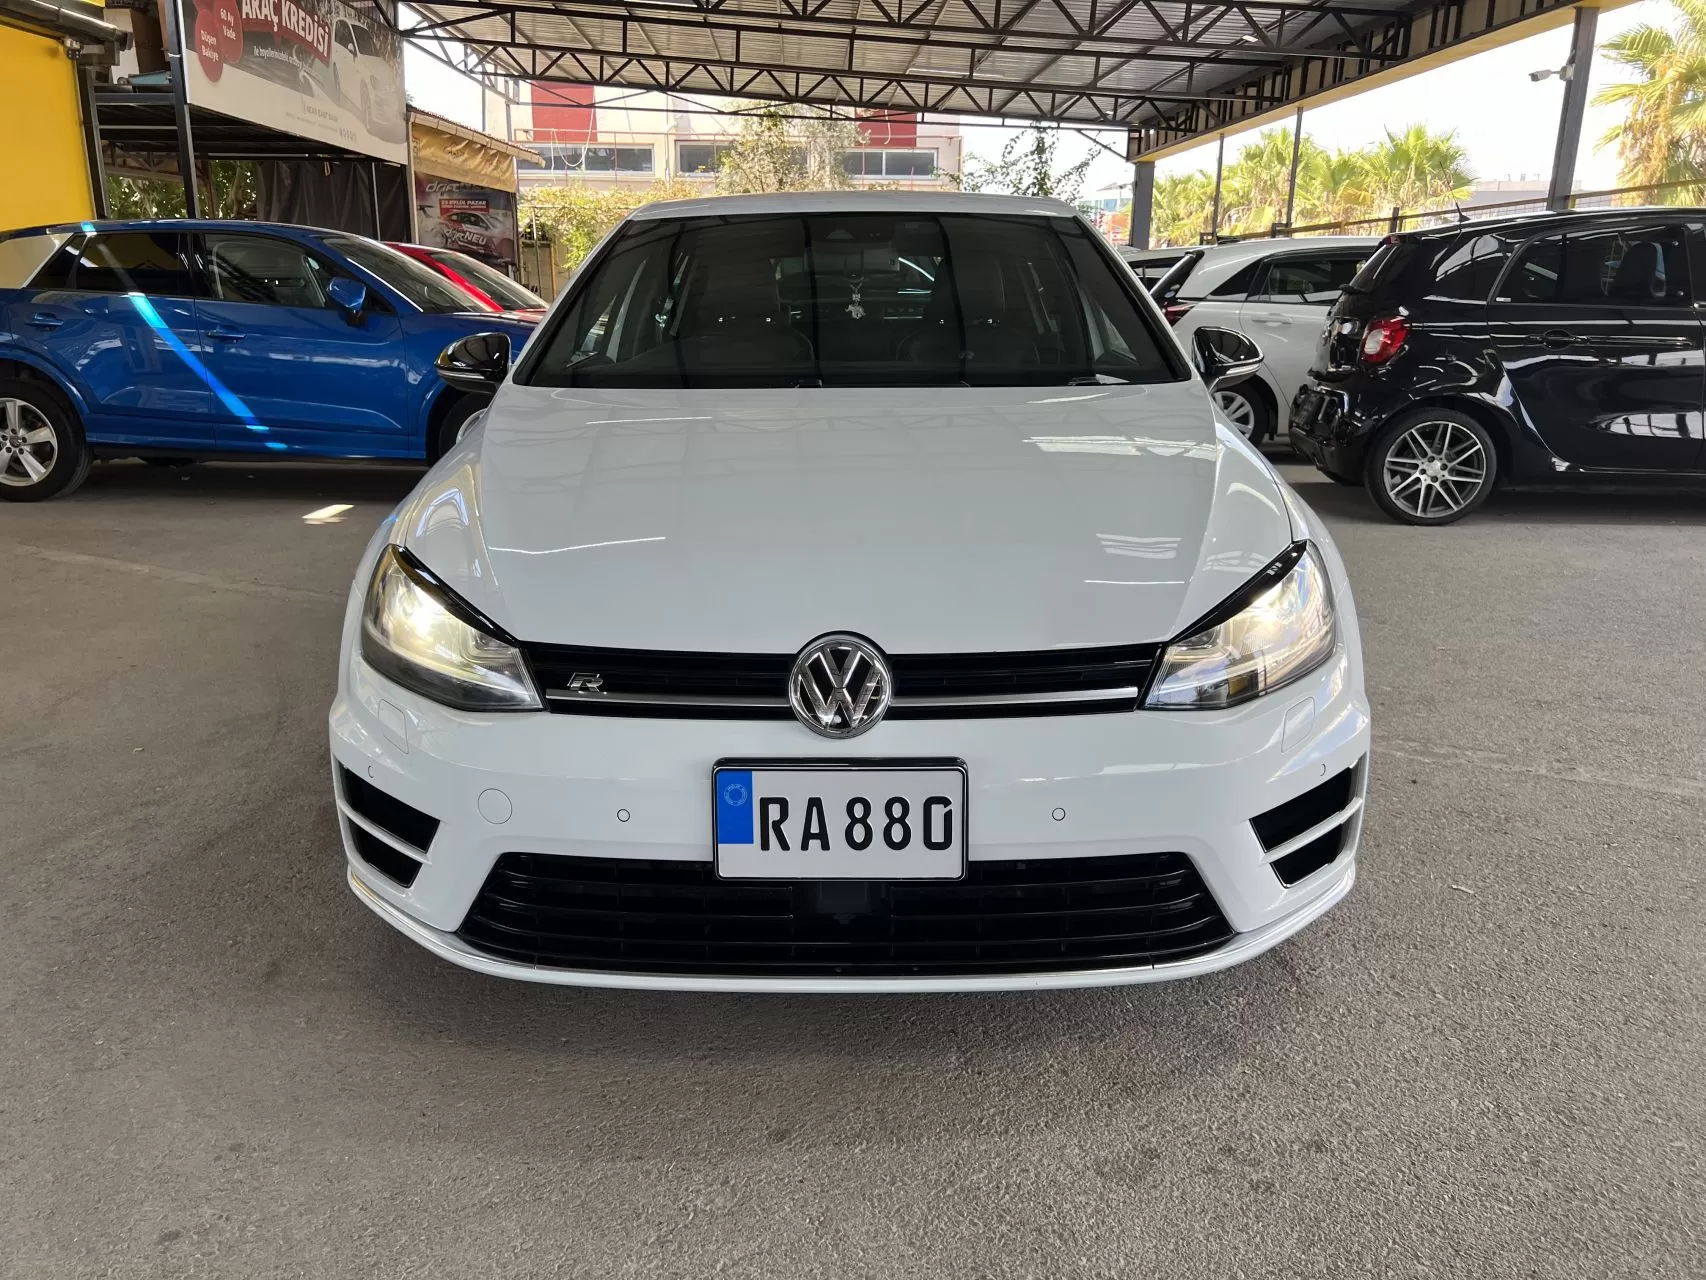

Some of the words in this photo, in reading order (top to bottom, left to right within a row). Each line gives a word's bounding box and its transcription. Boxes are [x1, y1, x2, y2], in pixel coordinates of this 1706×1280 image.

[220, 8, 227, 21] 60
[227, 11, 234, 27] Ay
[222, 24, 237, 41] Vade
[242, 0, 279, 32] ARAÇ
[281, 0, 329, 57] KREDİSİ
